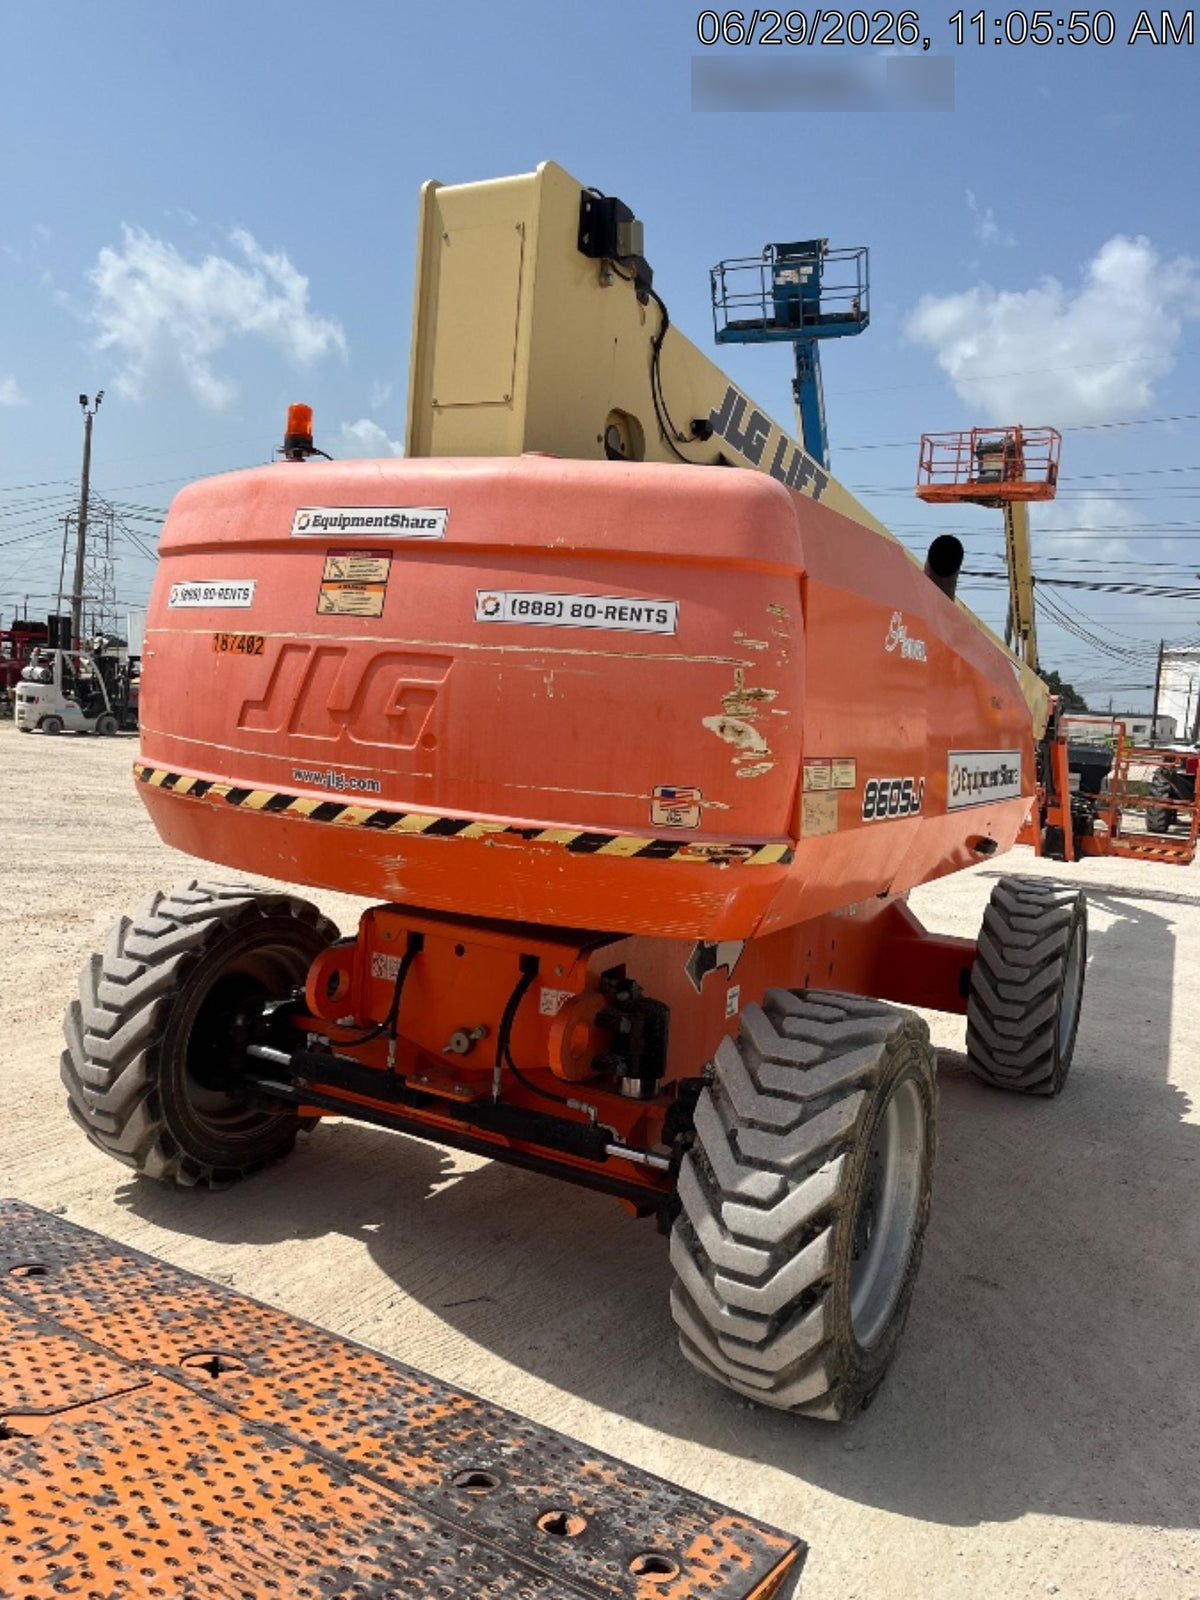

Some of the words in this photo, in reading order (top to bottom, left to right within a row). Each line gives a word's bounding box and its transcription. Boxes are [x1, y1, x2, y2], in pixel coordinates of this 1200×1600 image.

[708, 384, 772, 468] JLG
[769, 432, 830, 502] LIFT
[312, 513, 437, 530] EquipmentShare
[511, 599, 563, 617] (888)
[571, 604, 668, 624] 80-RENTS
[213, 632, 265, 655] 187402
[237, 643, 455, 750] JLG
[292, 768, 381, 792] www.jlg.com
[862, 777, 925, 820] 860SJ
